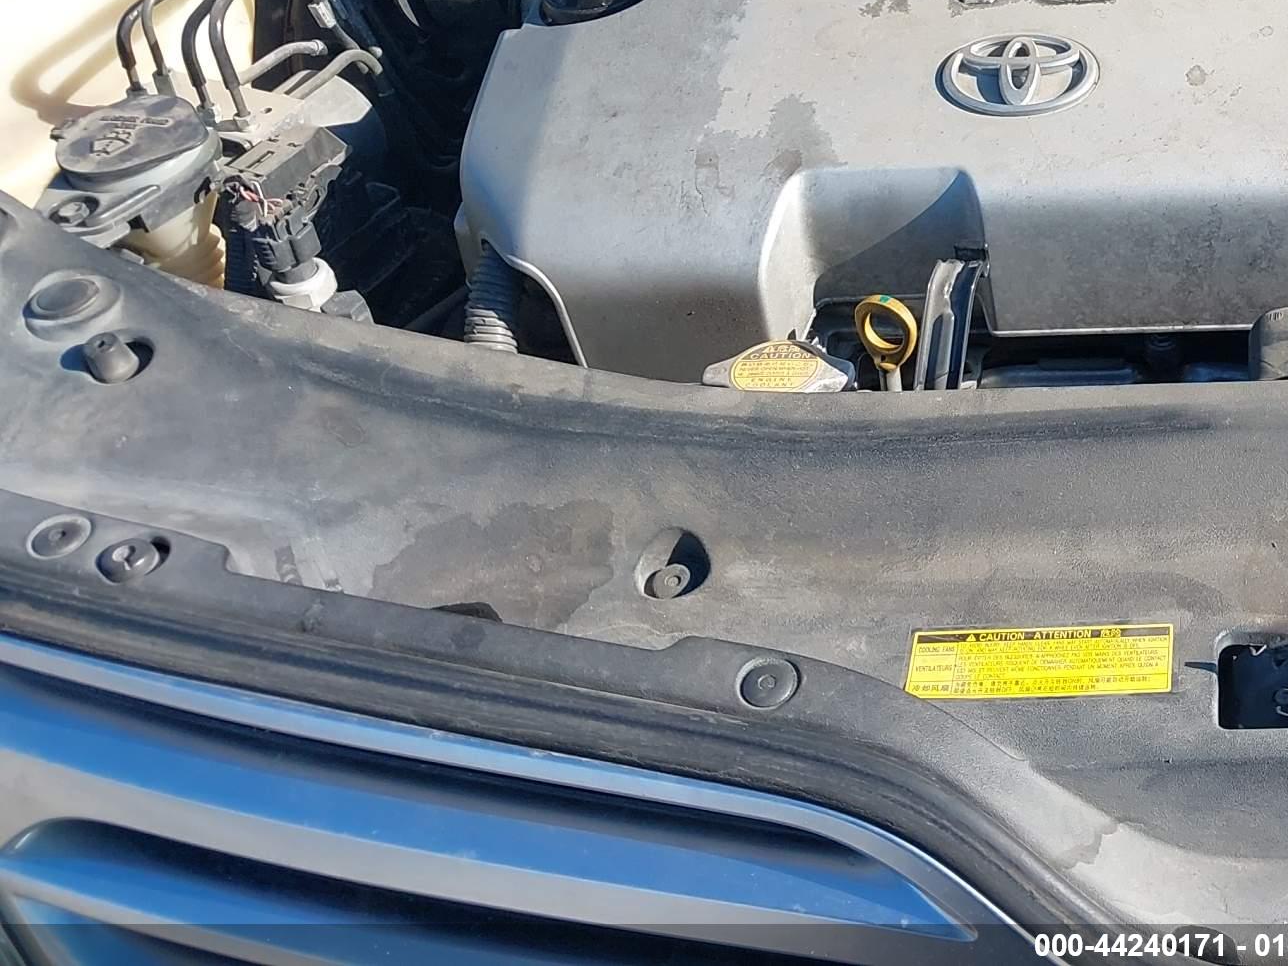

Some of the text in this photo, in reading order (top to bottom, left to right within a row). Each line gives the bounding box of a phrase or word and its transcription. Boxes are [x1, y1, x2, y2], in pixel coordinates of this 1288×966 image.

[749, 352, 811, 360] CAUTION
[979, 630, 1092, 642] CAUTION ATTENTION
